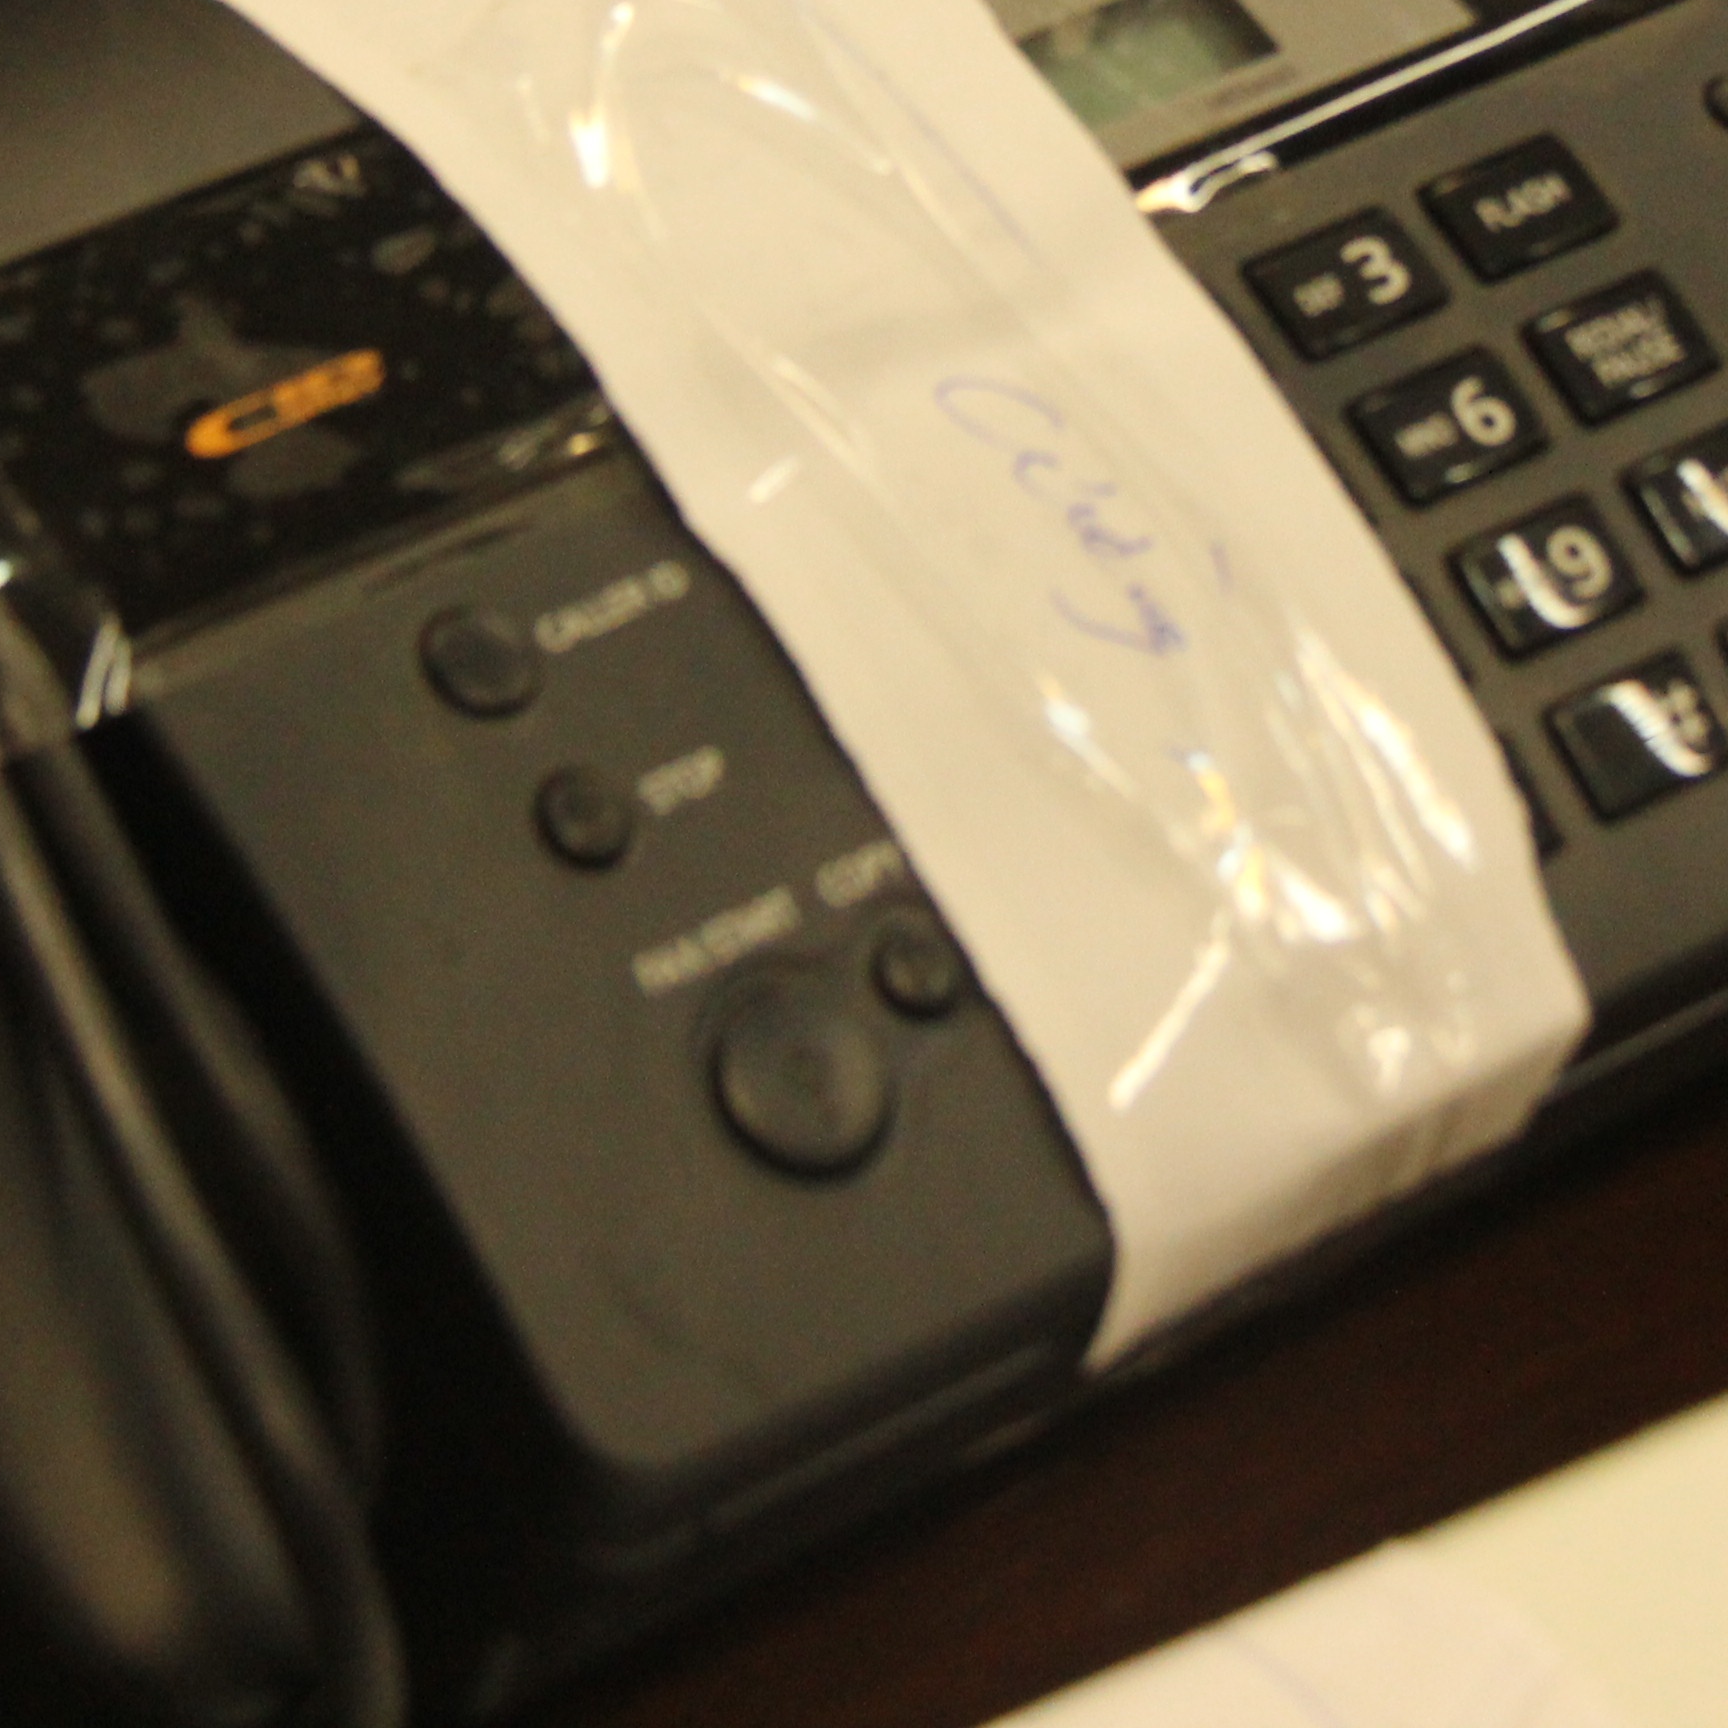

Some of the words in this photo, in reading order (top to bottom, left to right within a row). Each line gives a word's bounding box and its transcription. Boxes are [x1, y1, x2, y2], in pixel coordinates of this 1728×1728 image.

[1340, 235, 1412, 305] 3
[1450, 375, 1517, 447] 6
[1545, 524, 1613, 600] 9
